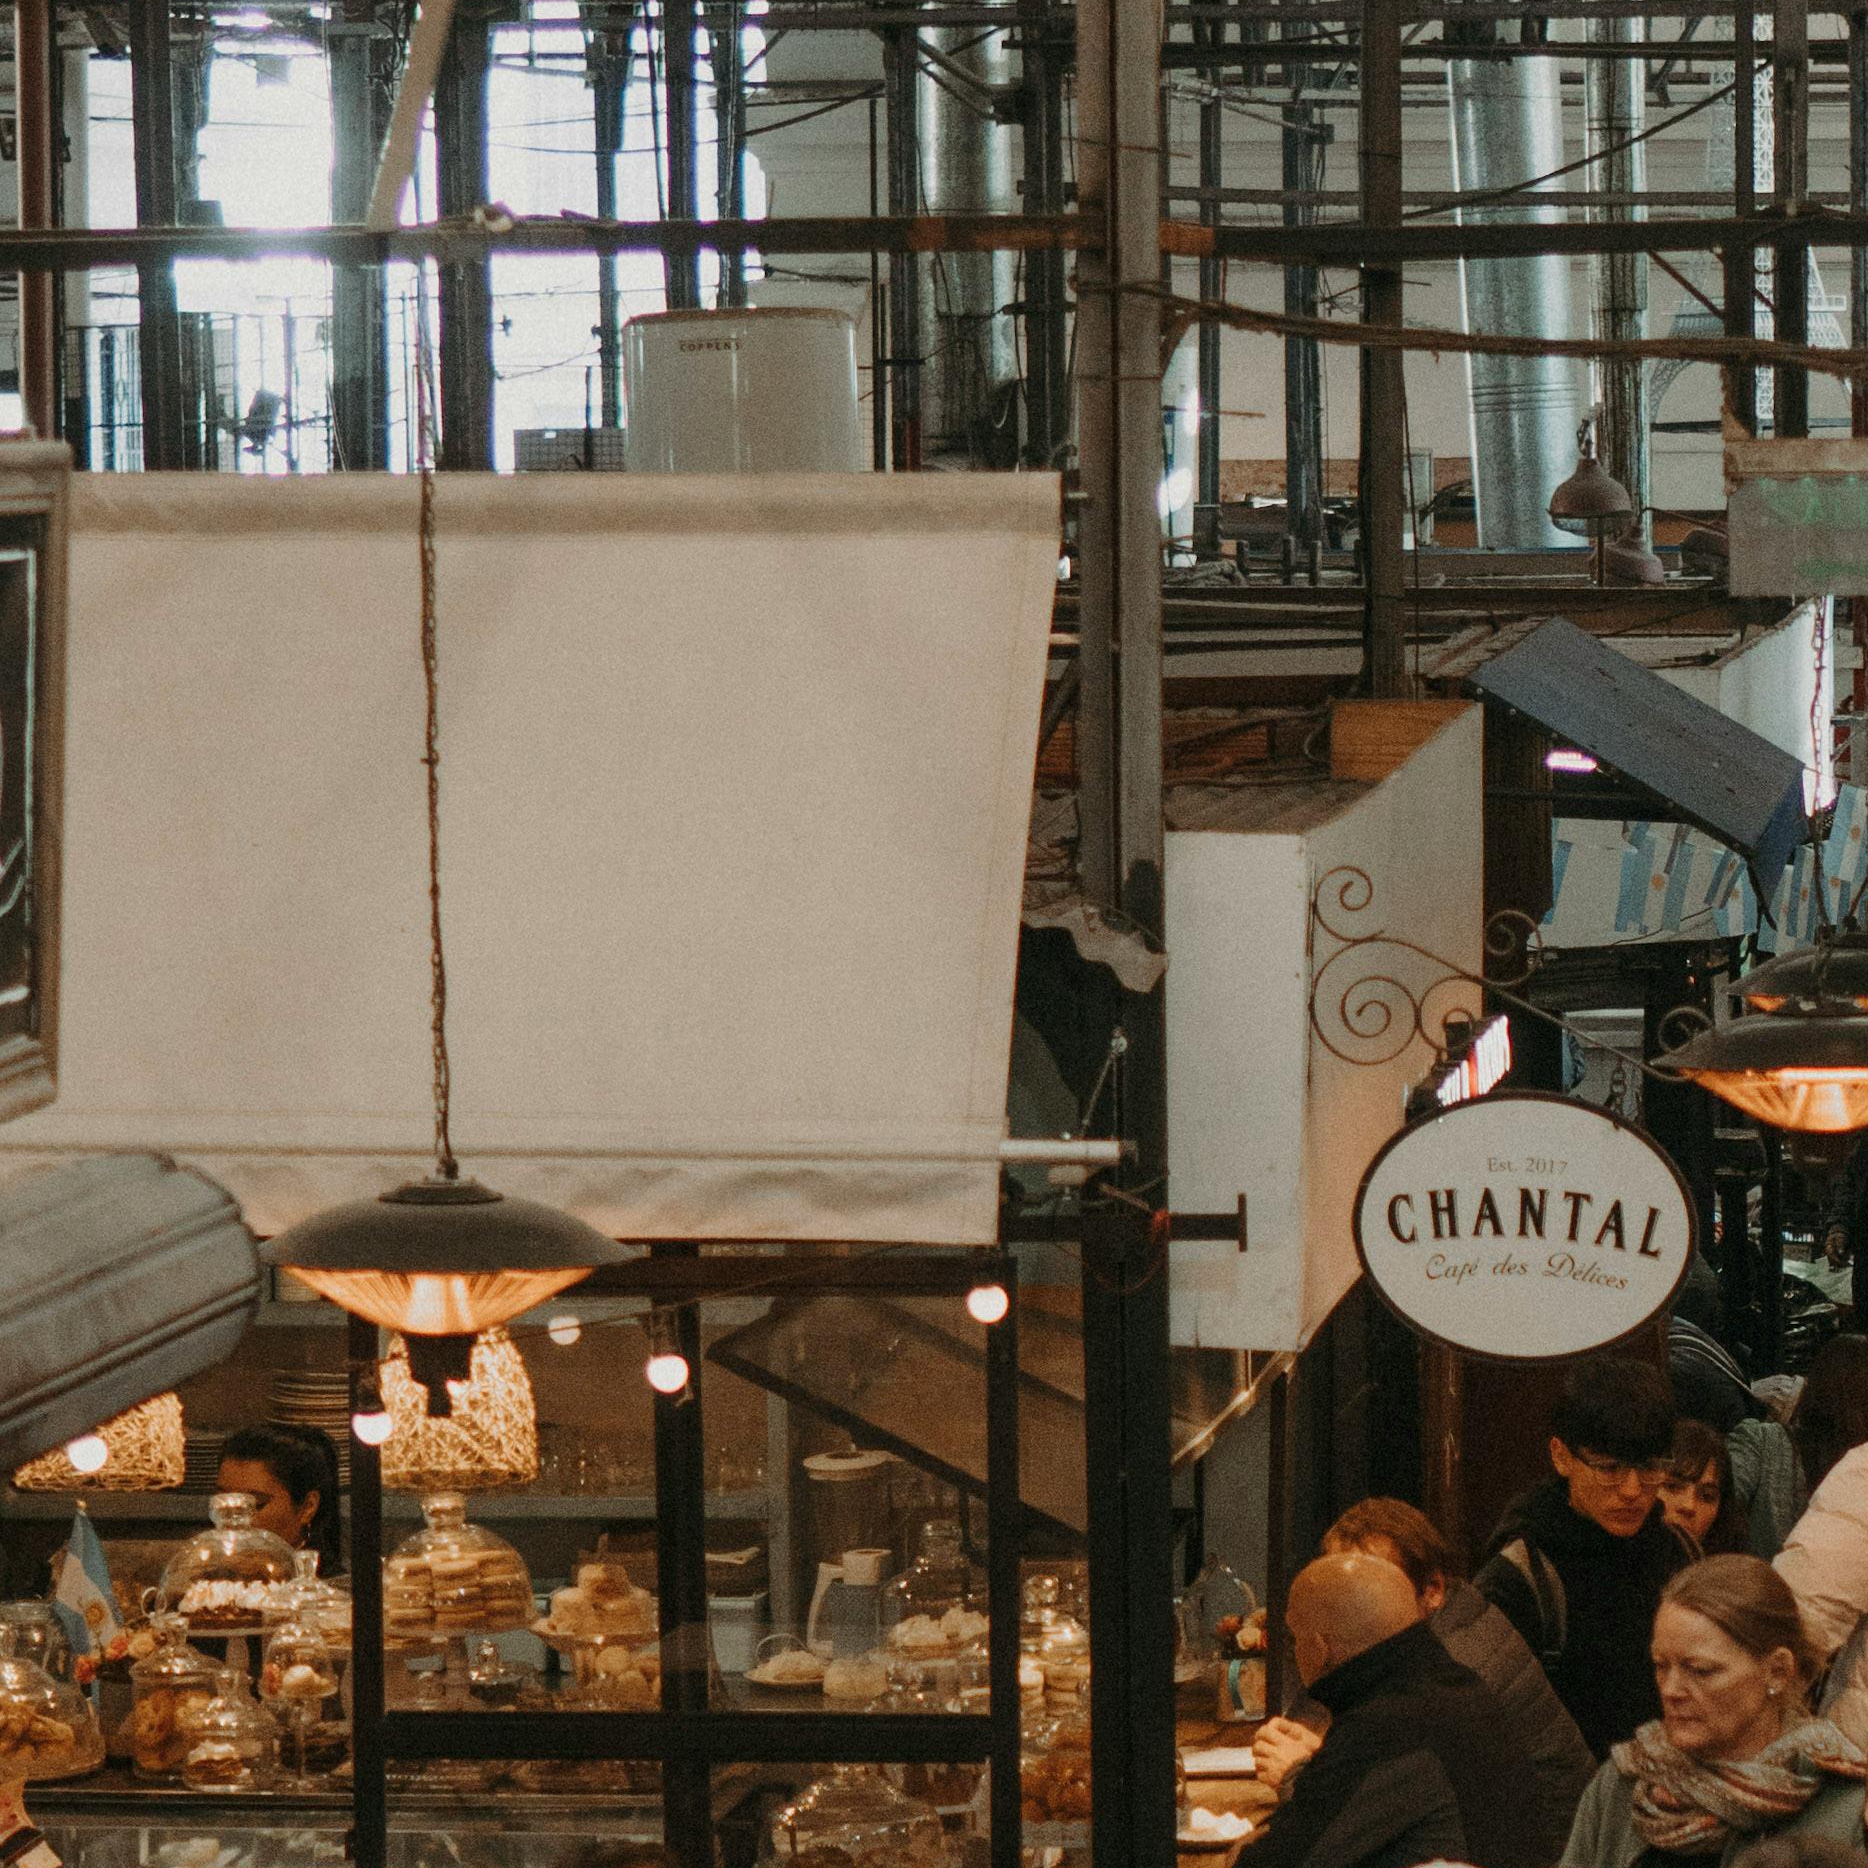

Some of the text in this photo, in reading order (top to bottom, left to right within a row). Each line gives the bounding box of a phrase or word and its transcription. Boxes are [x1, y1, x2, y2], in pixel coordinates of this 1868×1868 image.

[1486, 1156, 1569, 1175] Est. 2017
[1386, 1187, 1662, 1260] CHANTAL
[1426, 1252, 1629, 1290] Café des Délices
